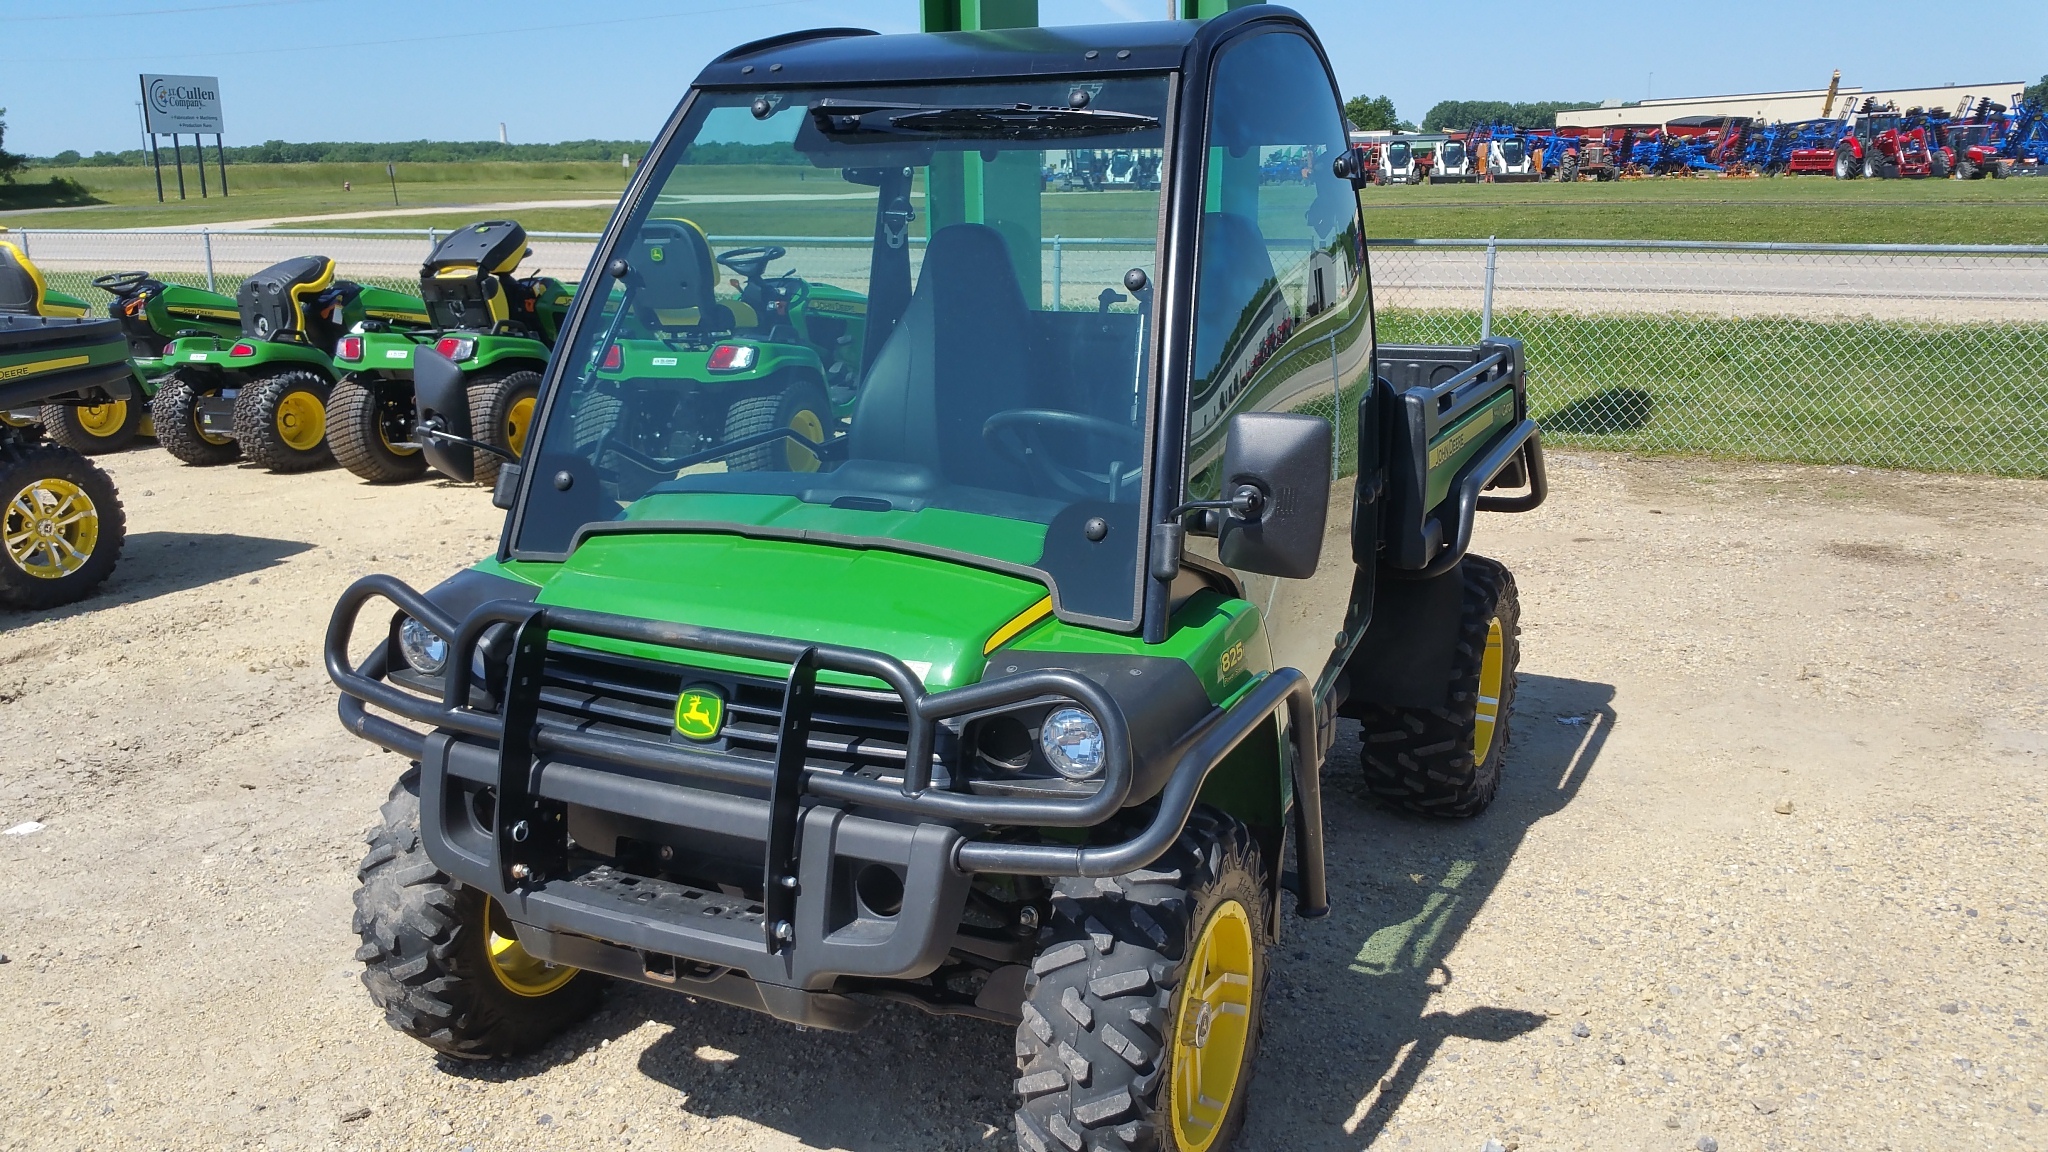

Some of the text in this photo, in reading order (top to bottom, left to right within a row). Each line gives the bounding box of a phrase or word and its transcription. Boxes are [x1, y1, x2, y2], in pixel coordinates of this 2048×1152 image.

[176, 86, 215, 100] Cullen
[169, 97, 206, 109] Company
[0, 367, 29, 379] DEERE
